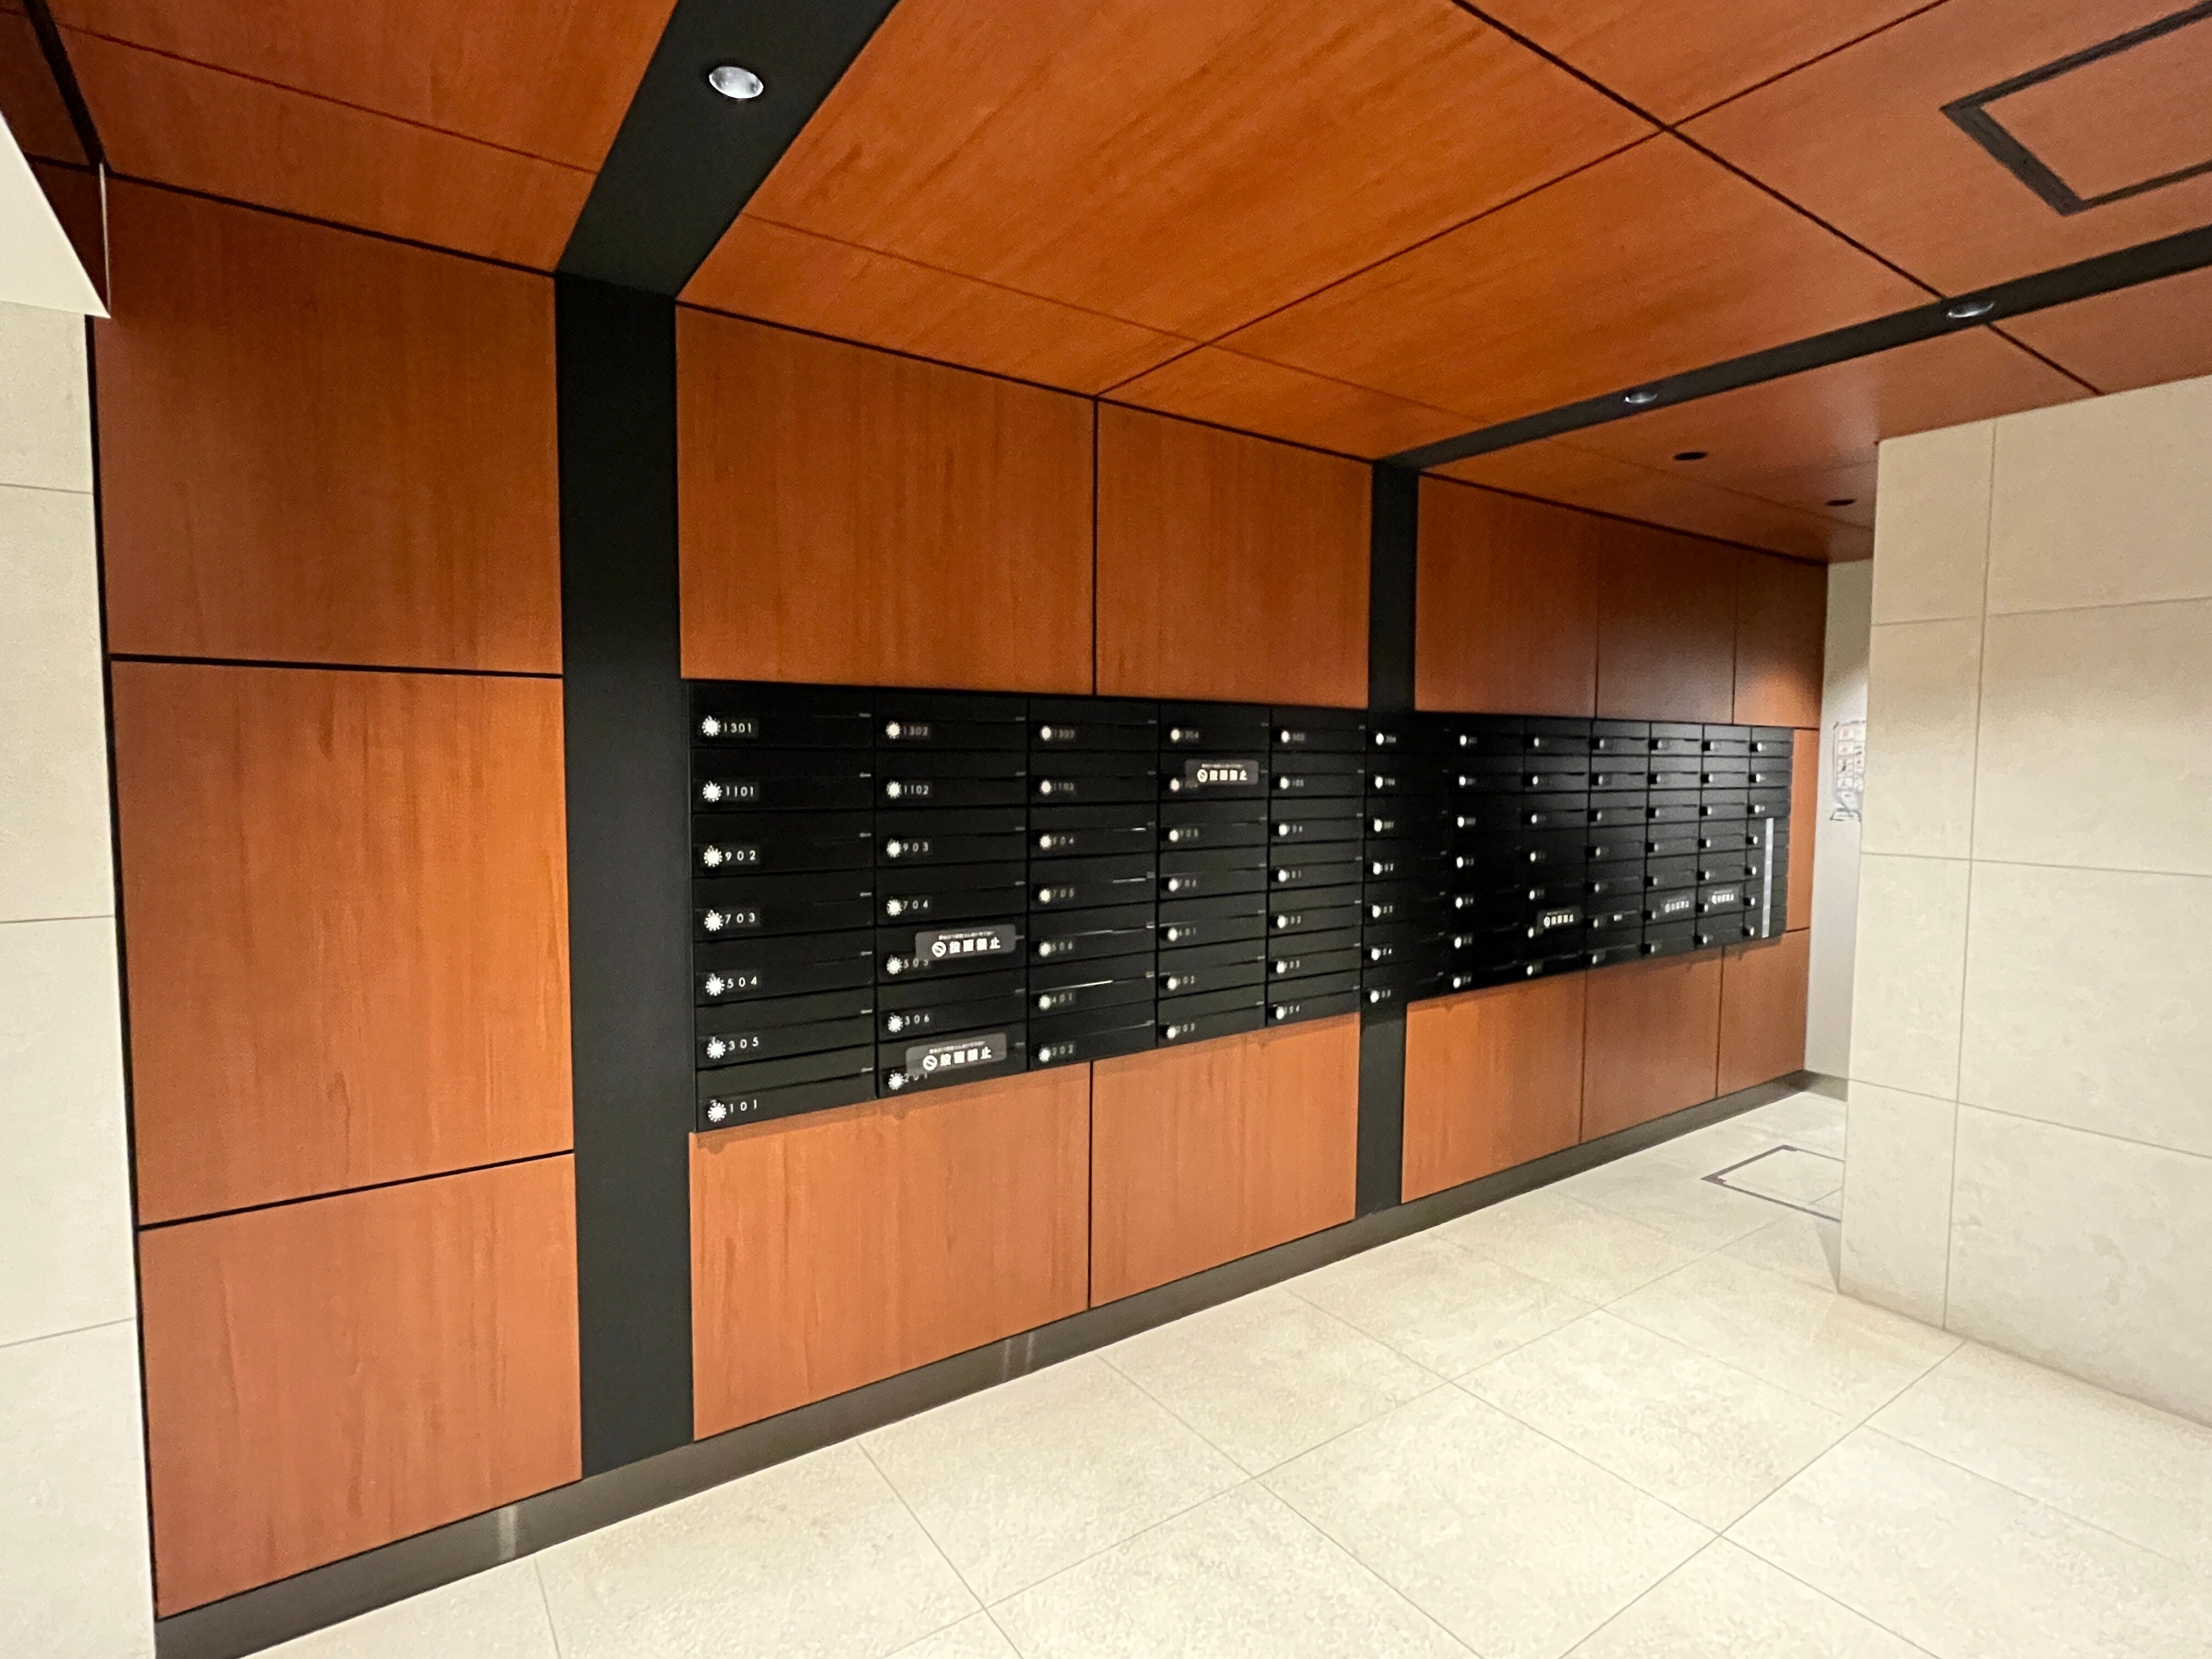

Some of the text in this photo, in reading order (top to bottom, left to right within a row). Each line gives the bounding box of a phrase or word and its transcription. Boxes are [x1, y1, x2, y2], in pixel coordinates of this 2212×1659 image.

[724, 723, 752, 733] 1301
[903, 725, 929, 736] 1302
[726, 786, 754, 797] 1101
[904, 784, 929, 795] 1102
[902, 842, 929, 852] 903
[725, 850, 756, 861] 902
[903, 899, 928, 911] 704
[724, 912, 756, 925] 703
[727, 975, 758, 989] 504
[904, 1013, 929, 1025] 306
[729, 1036, 759, 1051] 305
[729, 1098, 758, 1114] 101
